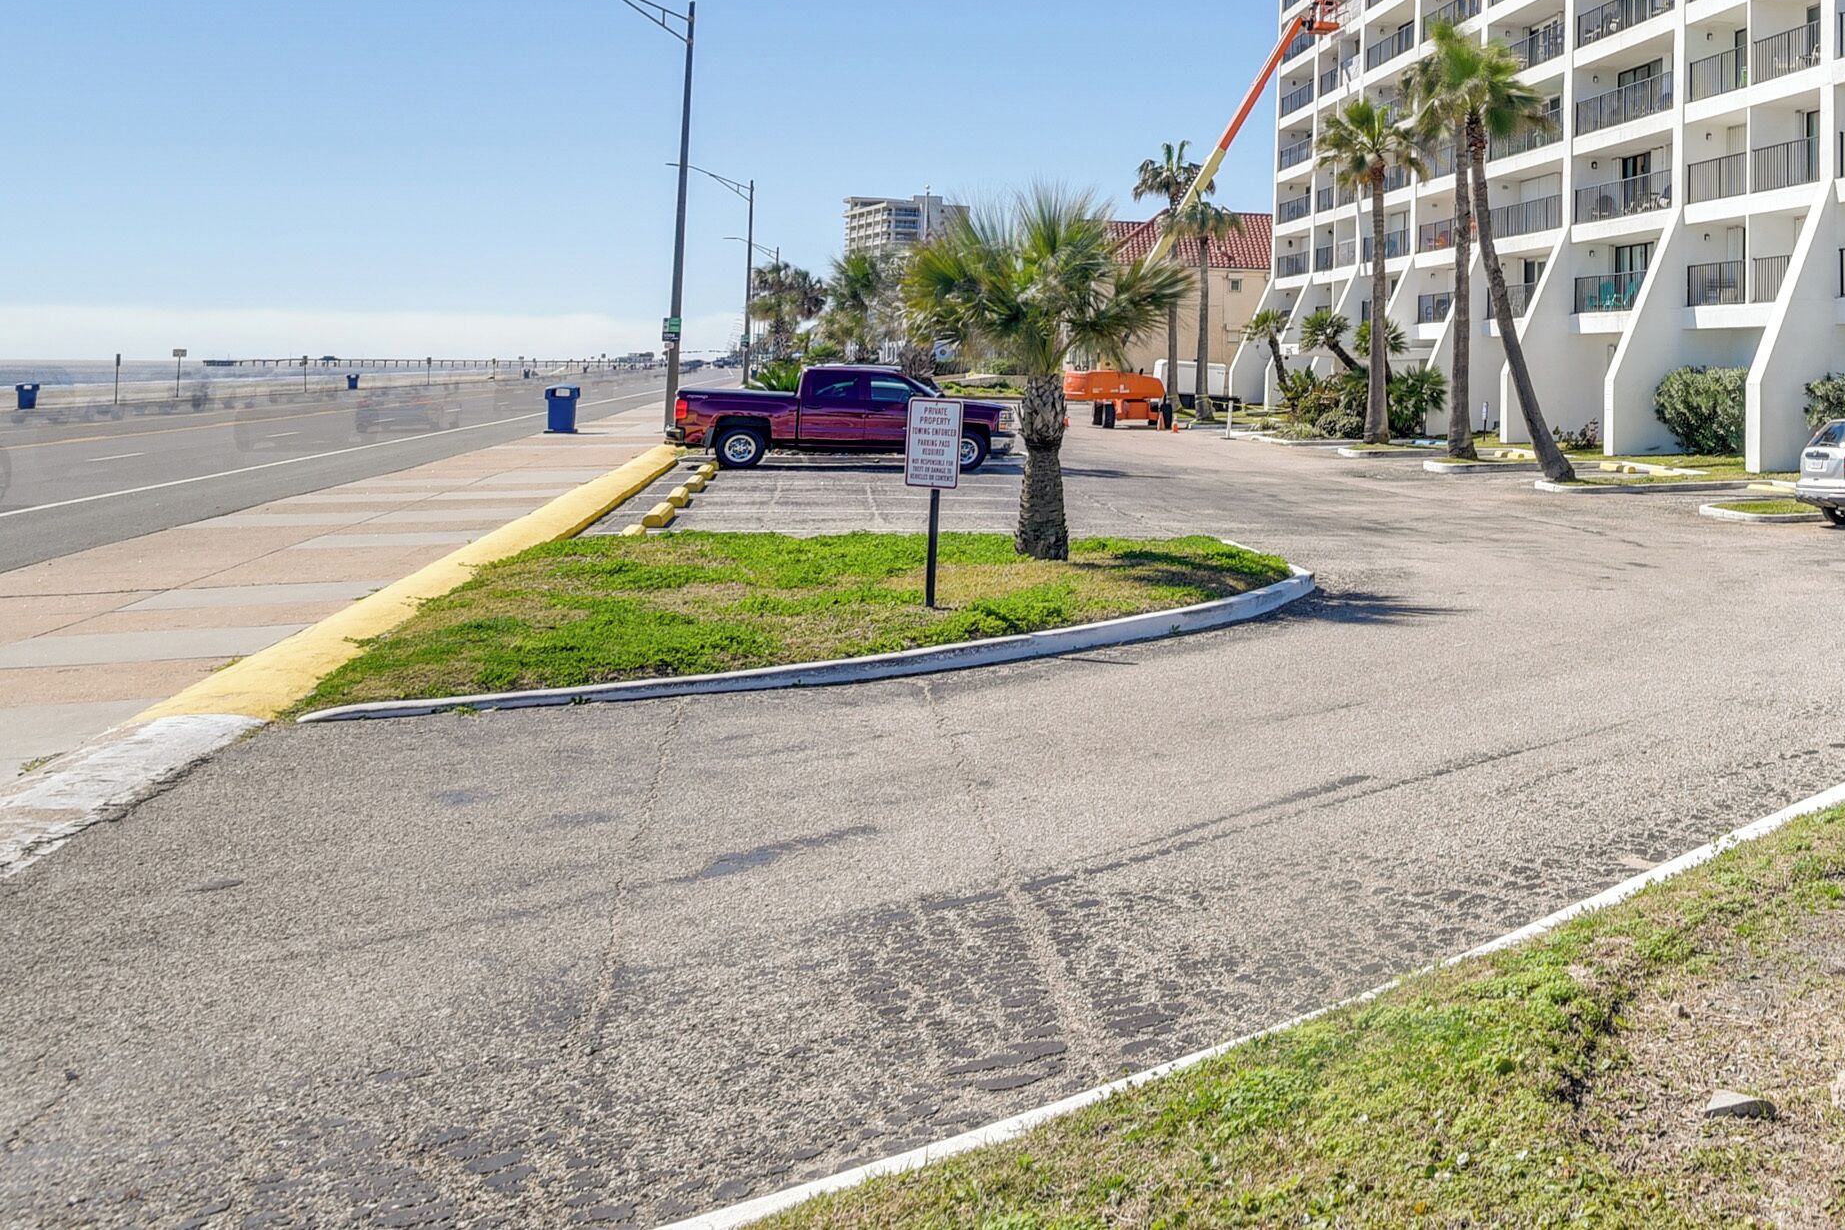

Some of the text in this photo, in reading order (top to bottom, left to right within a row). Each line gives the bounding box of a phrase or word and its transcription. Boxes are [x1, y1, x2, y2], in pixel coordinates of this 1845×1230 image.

[924, 406, 948, 416] PRIVATE
[920, 416, 951, 426] PROPERTY
[912, 426, 957, 437] TOWING ENFORCED
[918, 439, 951, 448] PARKING PASS
